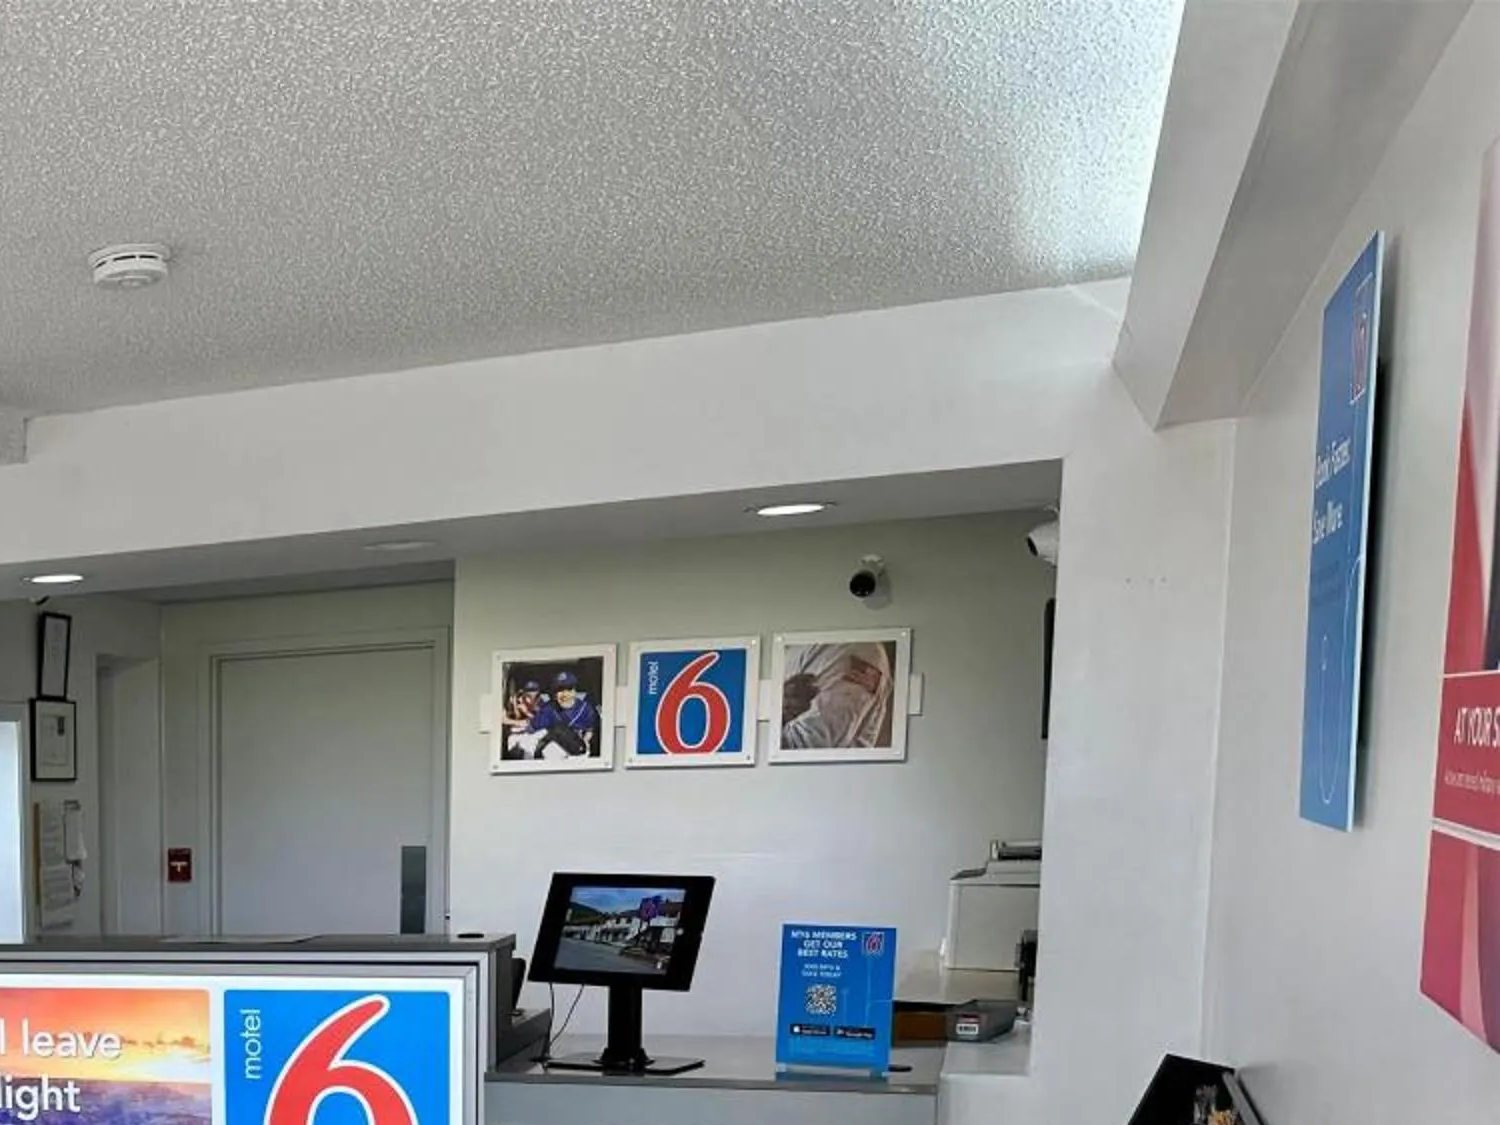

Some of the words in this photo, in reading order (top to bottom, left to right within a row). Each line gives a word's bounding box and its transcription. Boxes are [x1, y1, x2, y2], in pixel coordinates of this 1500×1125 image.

[648, 661, 658, 695] motel
[655, 651, 731, 755] 6
[1454, 707, 1466, 745] AT
[1467, 707, 1493, 747] YOUR
[22, 1018, 122, 1058] leave
[240, 1008, 261, 1080] motel
